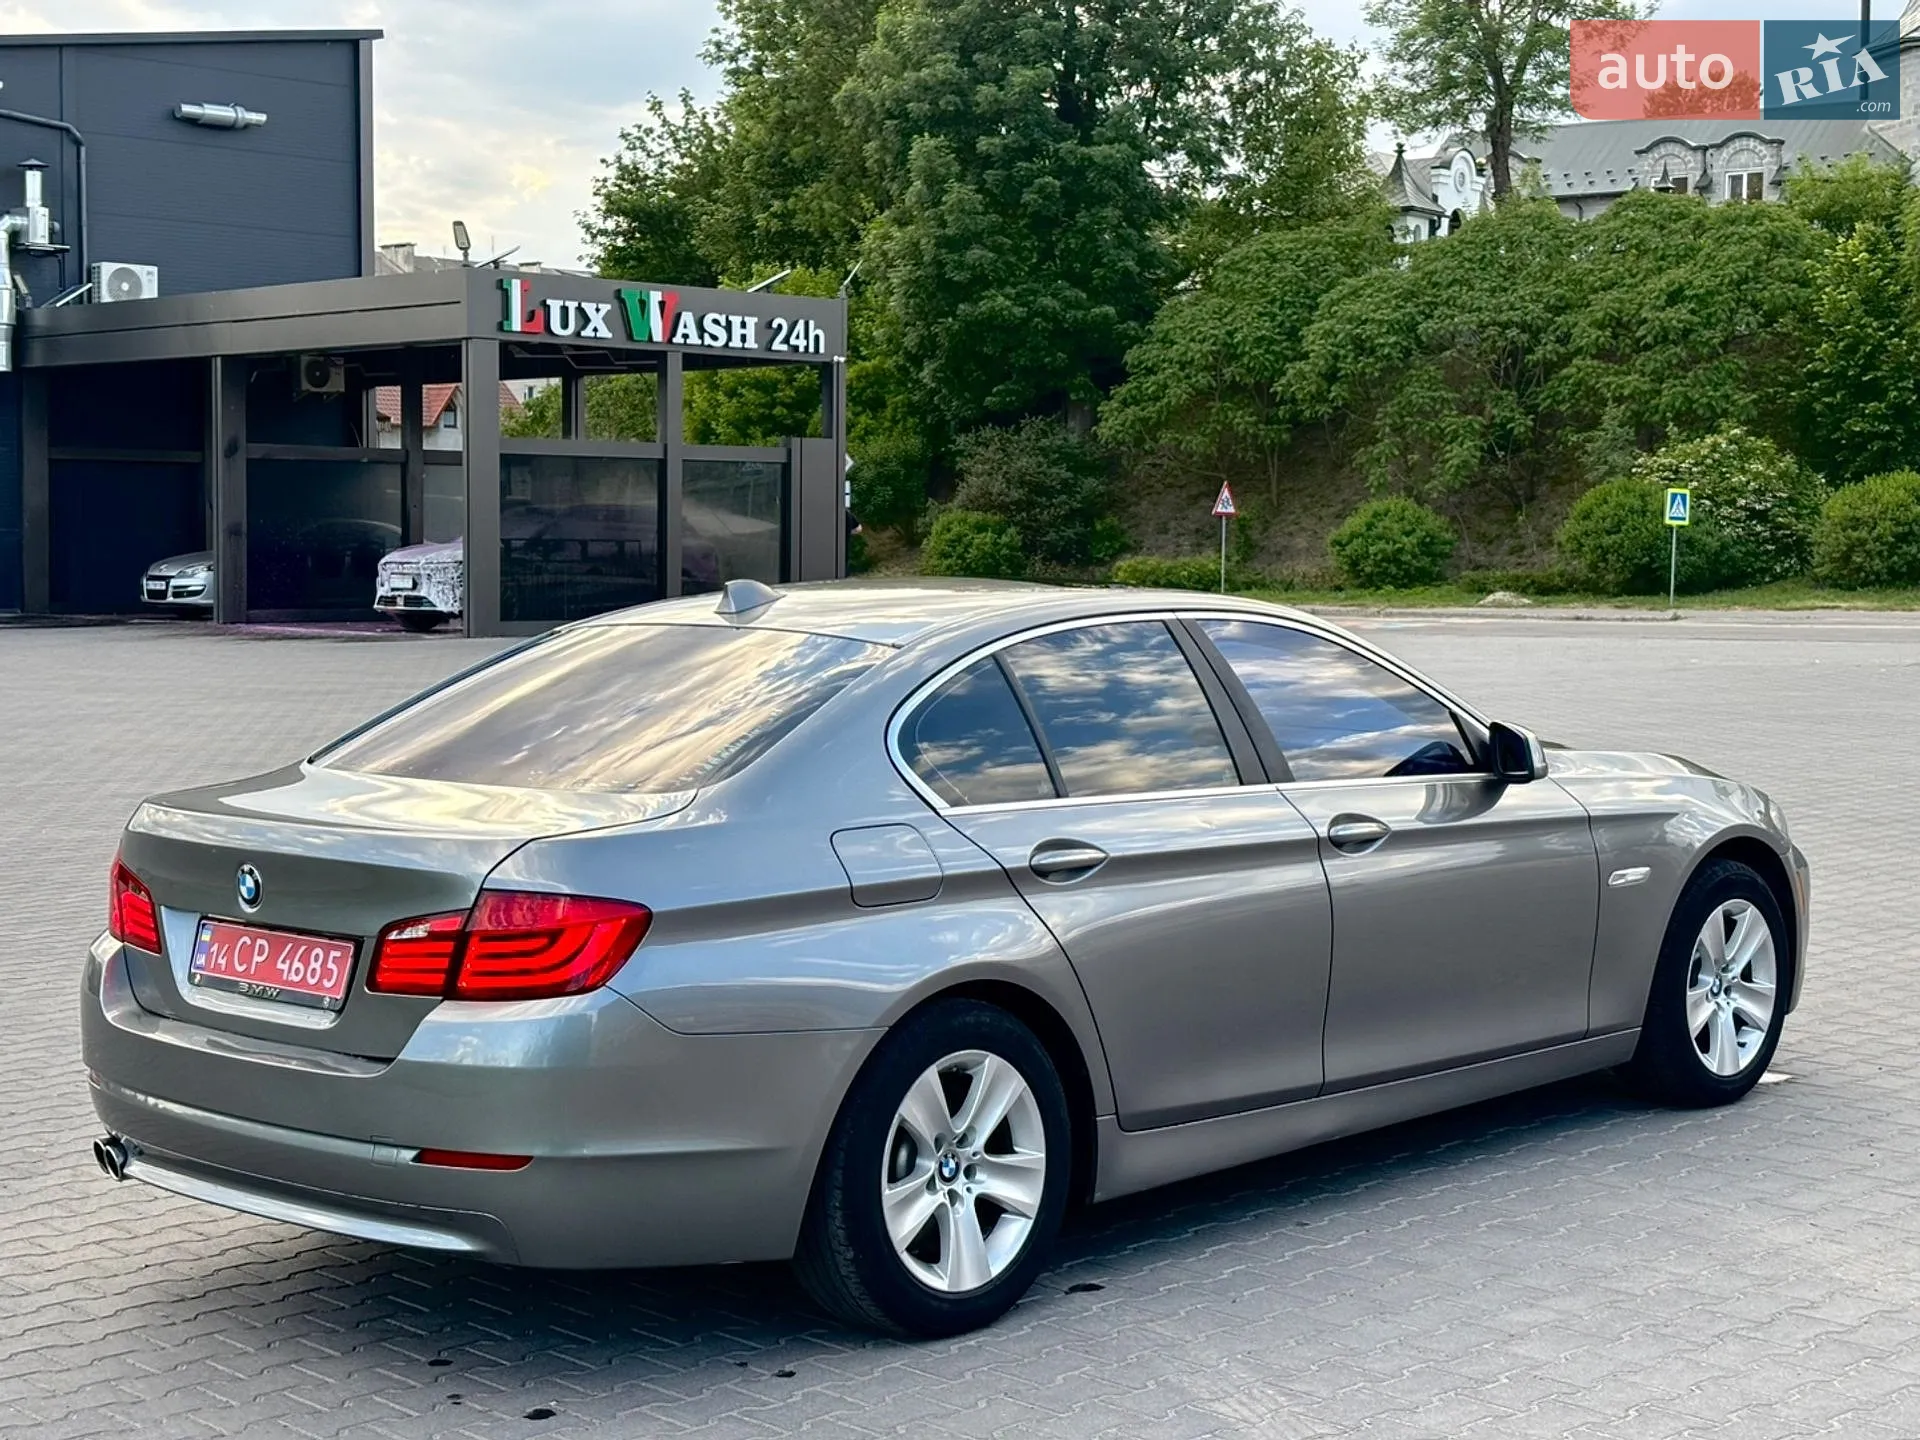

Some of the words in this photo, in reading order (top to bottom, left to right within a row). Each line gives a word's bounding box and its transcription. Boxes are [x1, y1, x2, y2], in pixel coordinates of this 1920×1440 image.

[771, 316, 826, 354] 24h
[209, 942, 230, 972] 14
[233, 935, 270, 975] CP
[276, 942, 342, 989] 4685
[238, 982, 281, 1000] BMW
